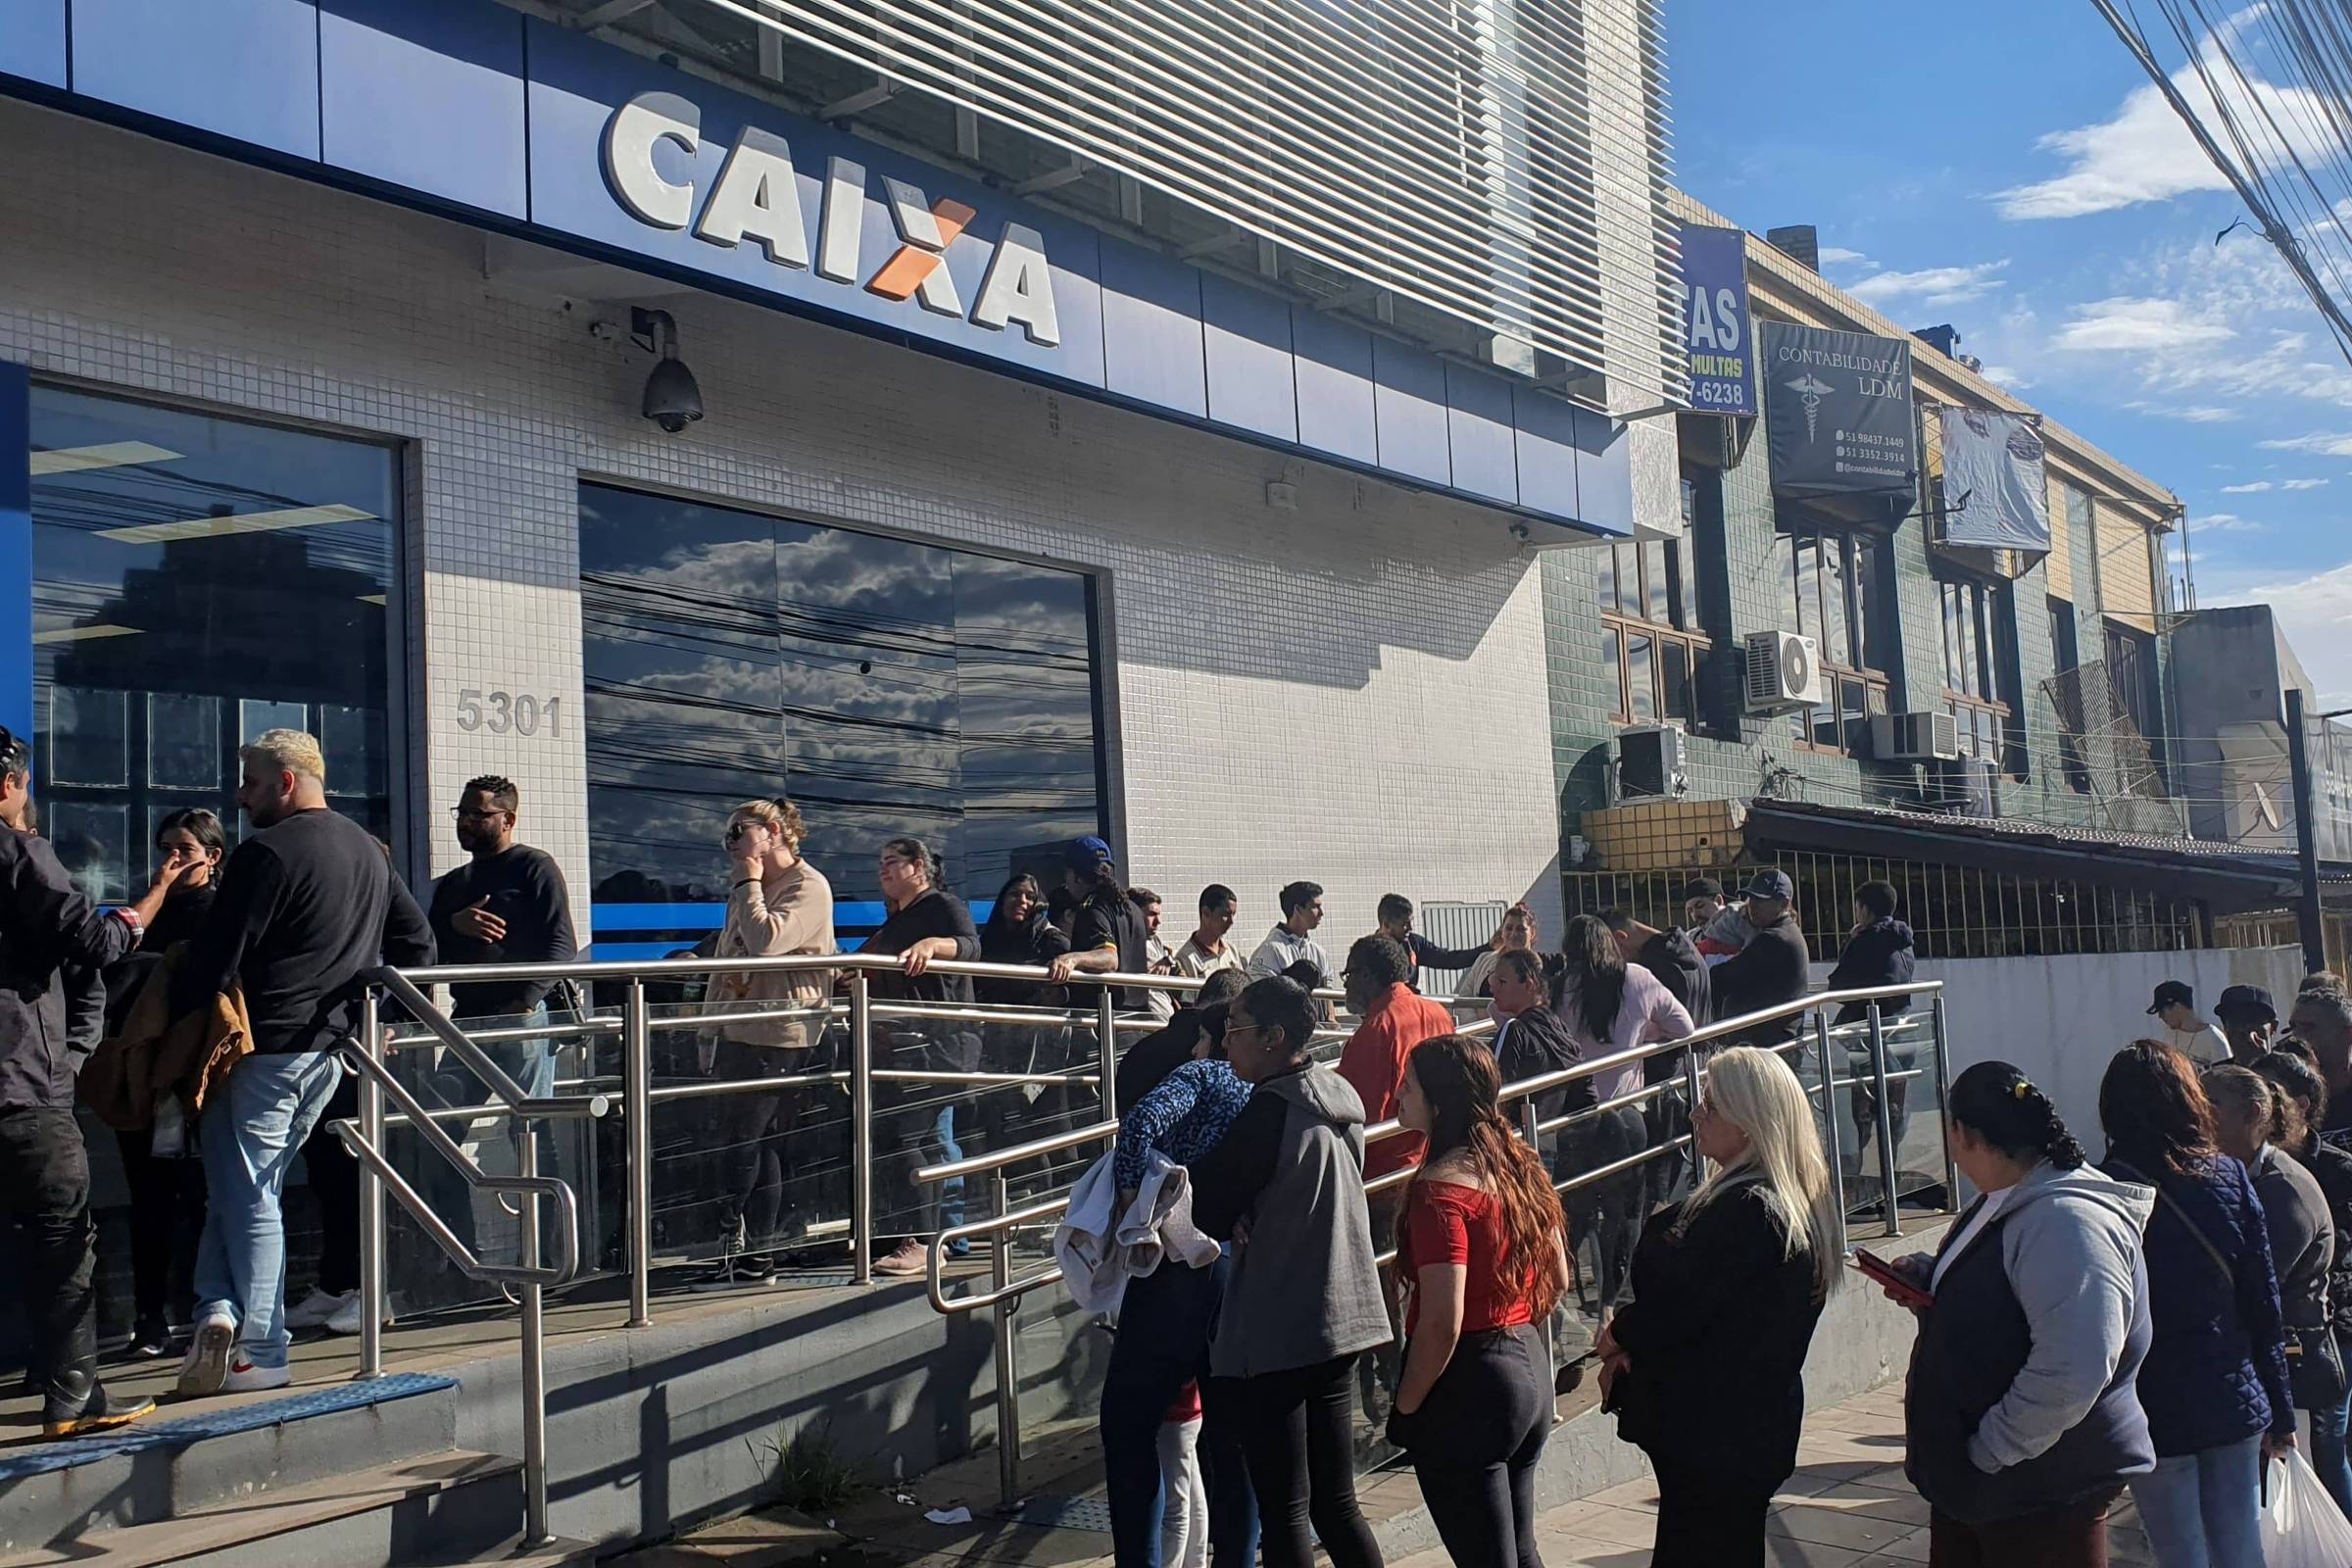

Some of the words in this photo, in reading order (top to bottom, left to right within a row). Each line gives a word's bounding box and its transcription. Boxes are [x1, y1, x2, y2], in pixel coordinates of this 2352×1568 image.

[598, 91, 1060, 348] CAIXA
[1690, 354, 1742, 378] MULTAS
[1779, 346, 1902, 375] CONTABILIDADE
[1858, 376, 1903, 401] LDM
[1845, 431, 1856, 442] 51
[1845, 447, 1856, 457] 51
[457, 688, 561, 738] 5301
